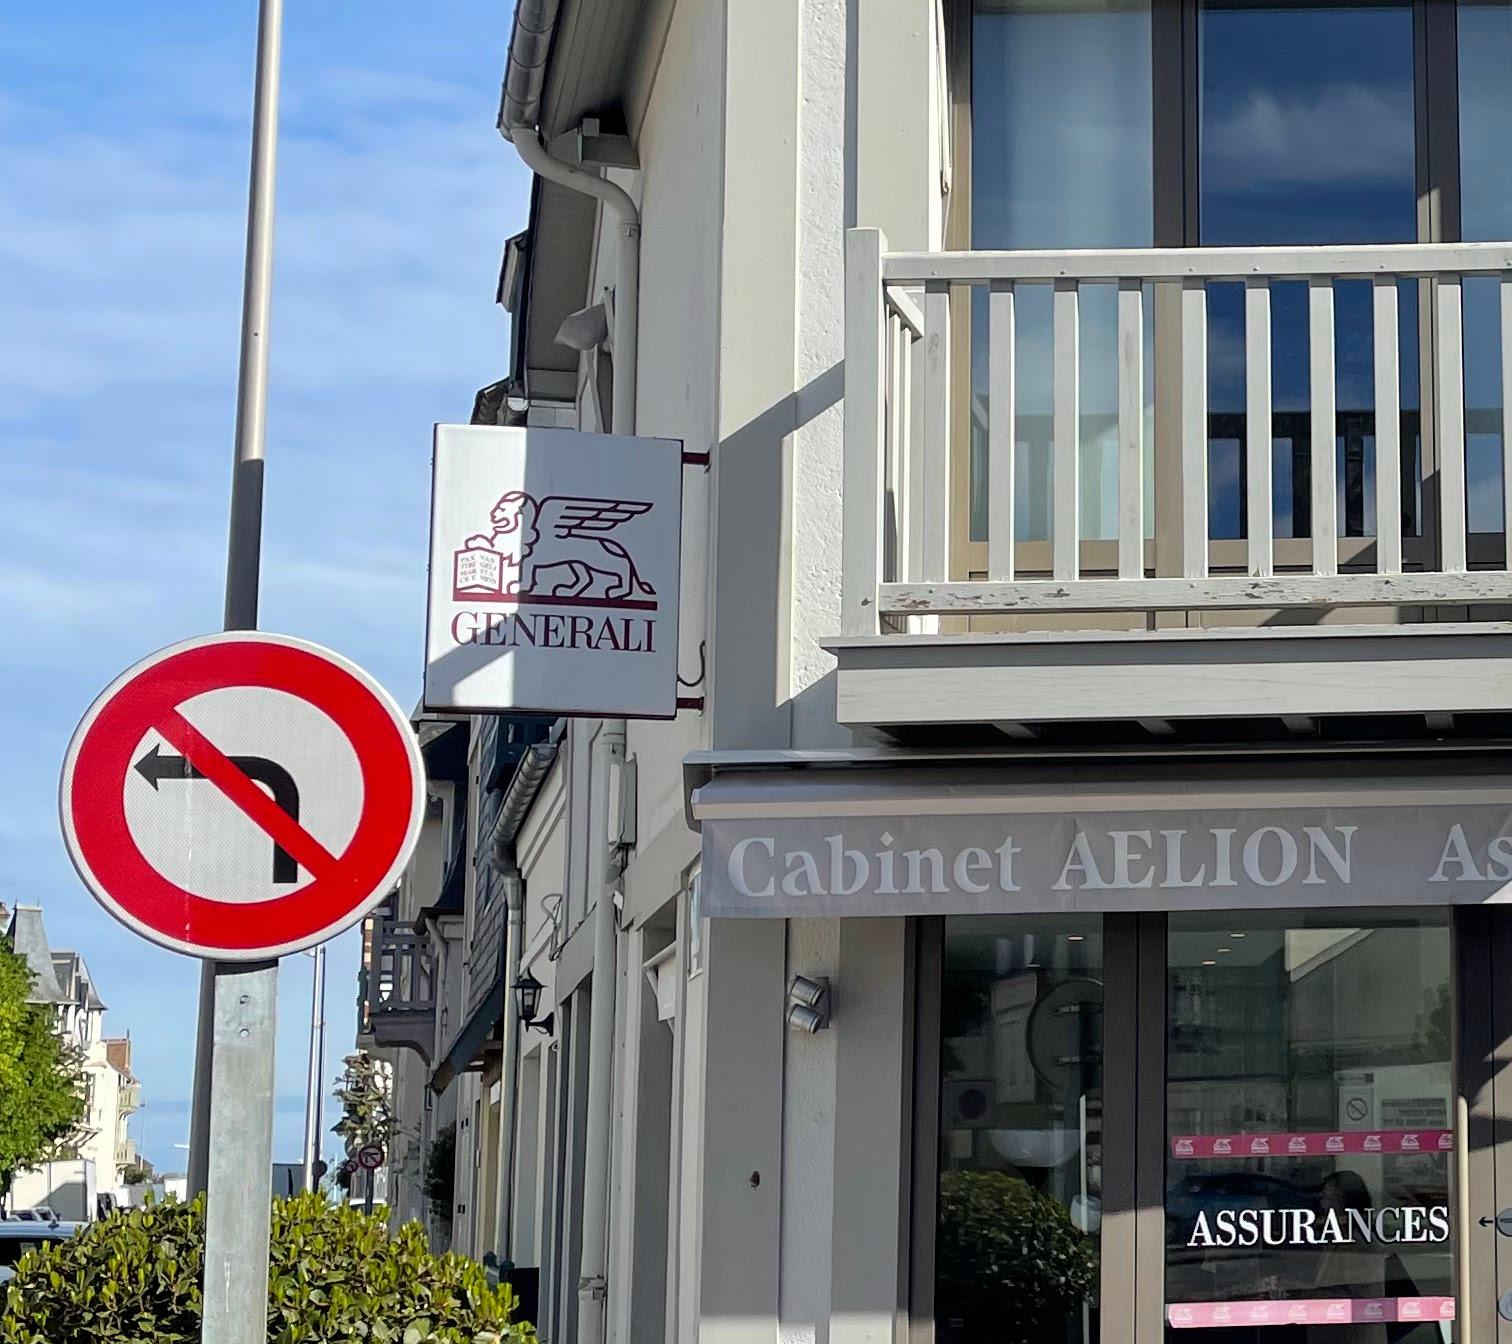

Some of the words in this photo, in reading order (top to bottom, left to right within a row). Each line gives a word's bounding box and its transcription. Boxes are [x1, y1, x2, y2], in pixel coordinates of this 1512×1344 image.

[451, 611, 657, 653] GENERALI
[727, 830, 1022, 898] Cabinet
[1051, 824, 1358, 889] AELION
[1187, 1206, 1450, 1247] ASSURANCES
